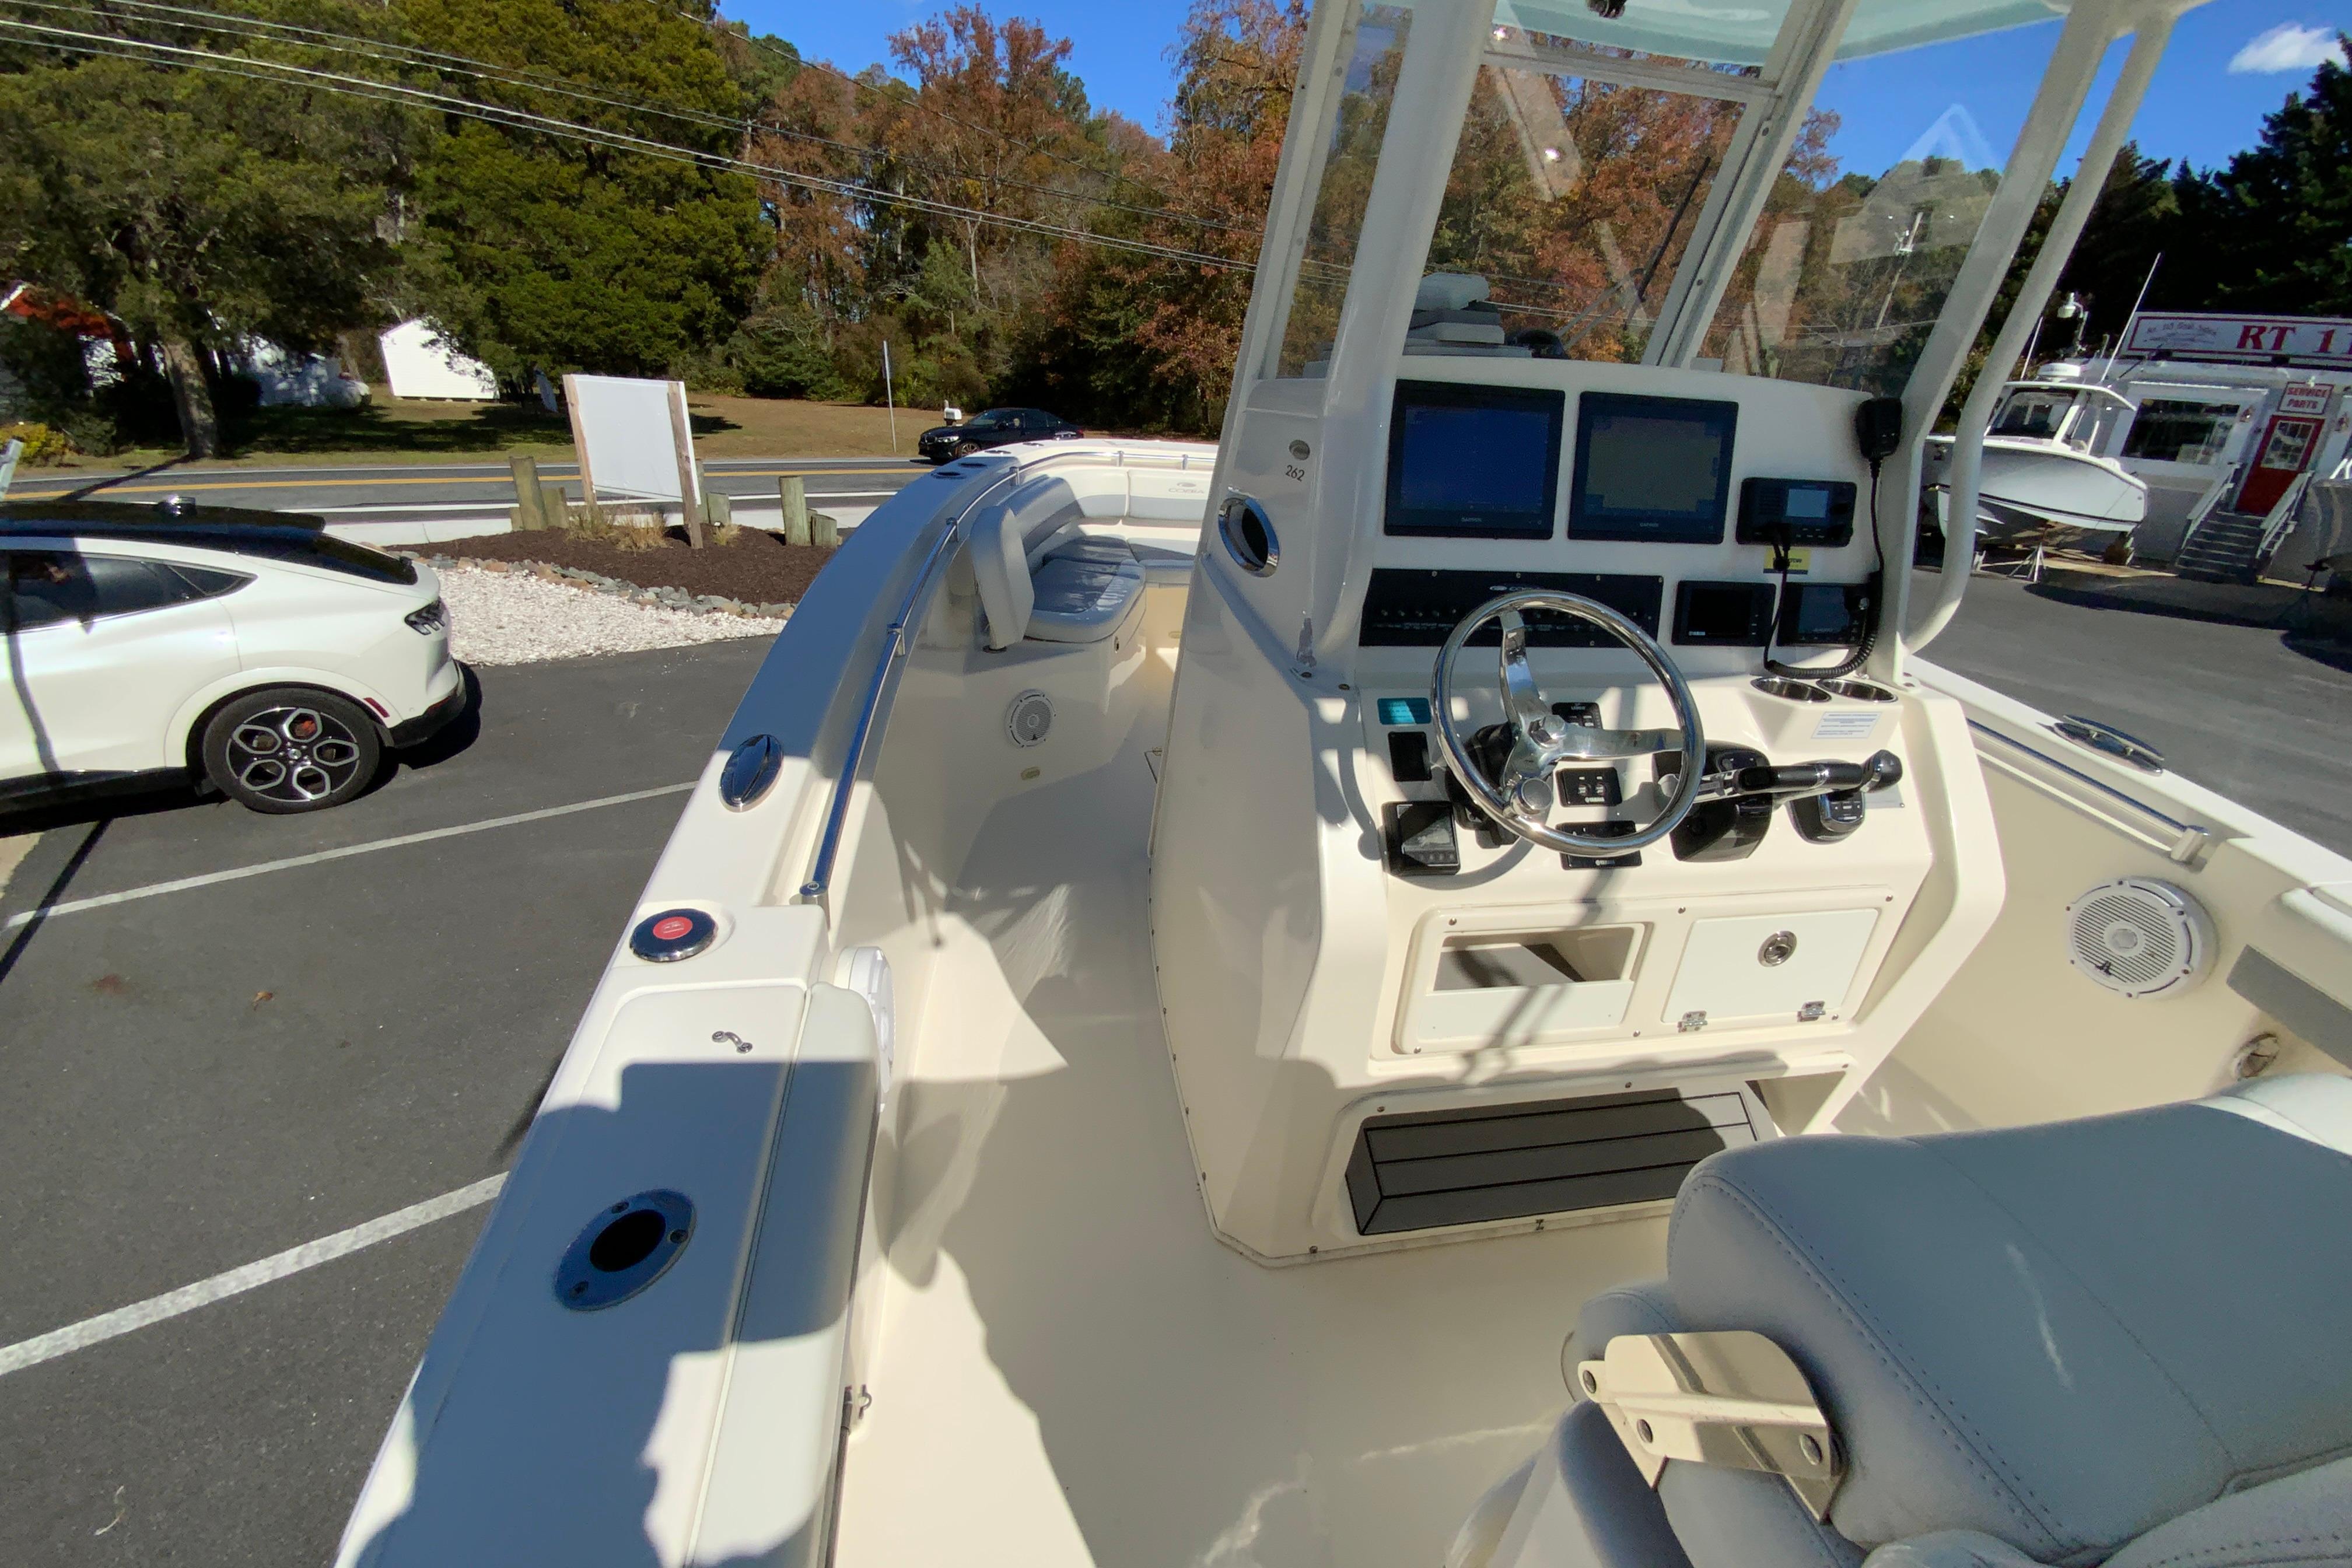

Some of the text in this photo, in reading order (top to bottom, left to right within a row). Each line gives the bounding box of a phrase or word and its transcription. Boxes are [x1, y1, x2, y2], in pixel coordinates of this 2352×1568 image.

[2236, 325, 2297, 351] RT
[2286, 387, 2328, 398] SERVICE
[2287, 398, 2319, 409] PARTS
[1285, 464, 1306, 482] 262
